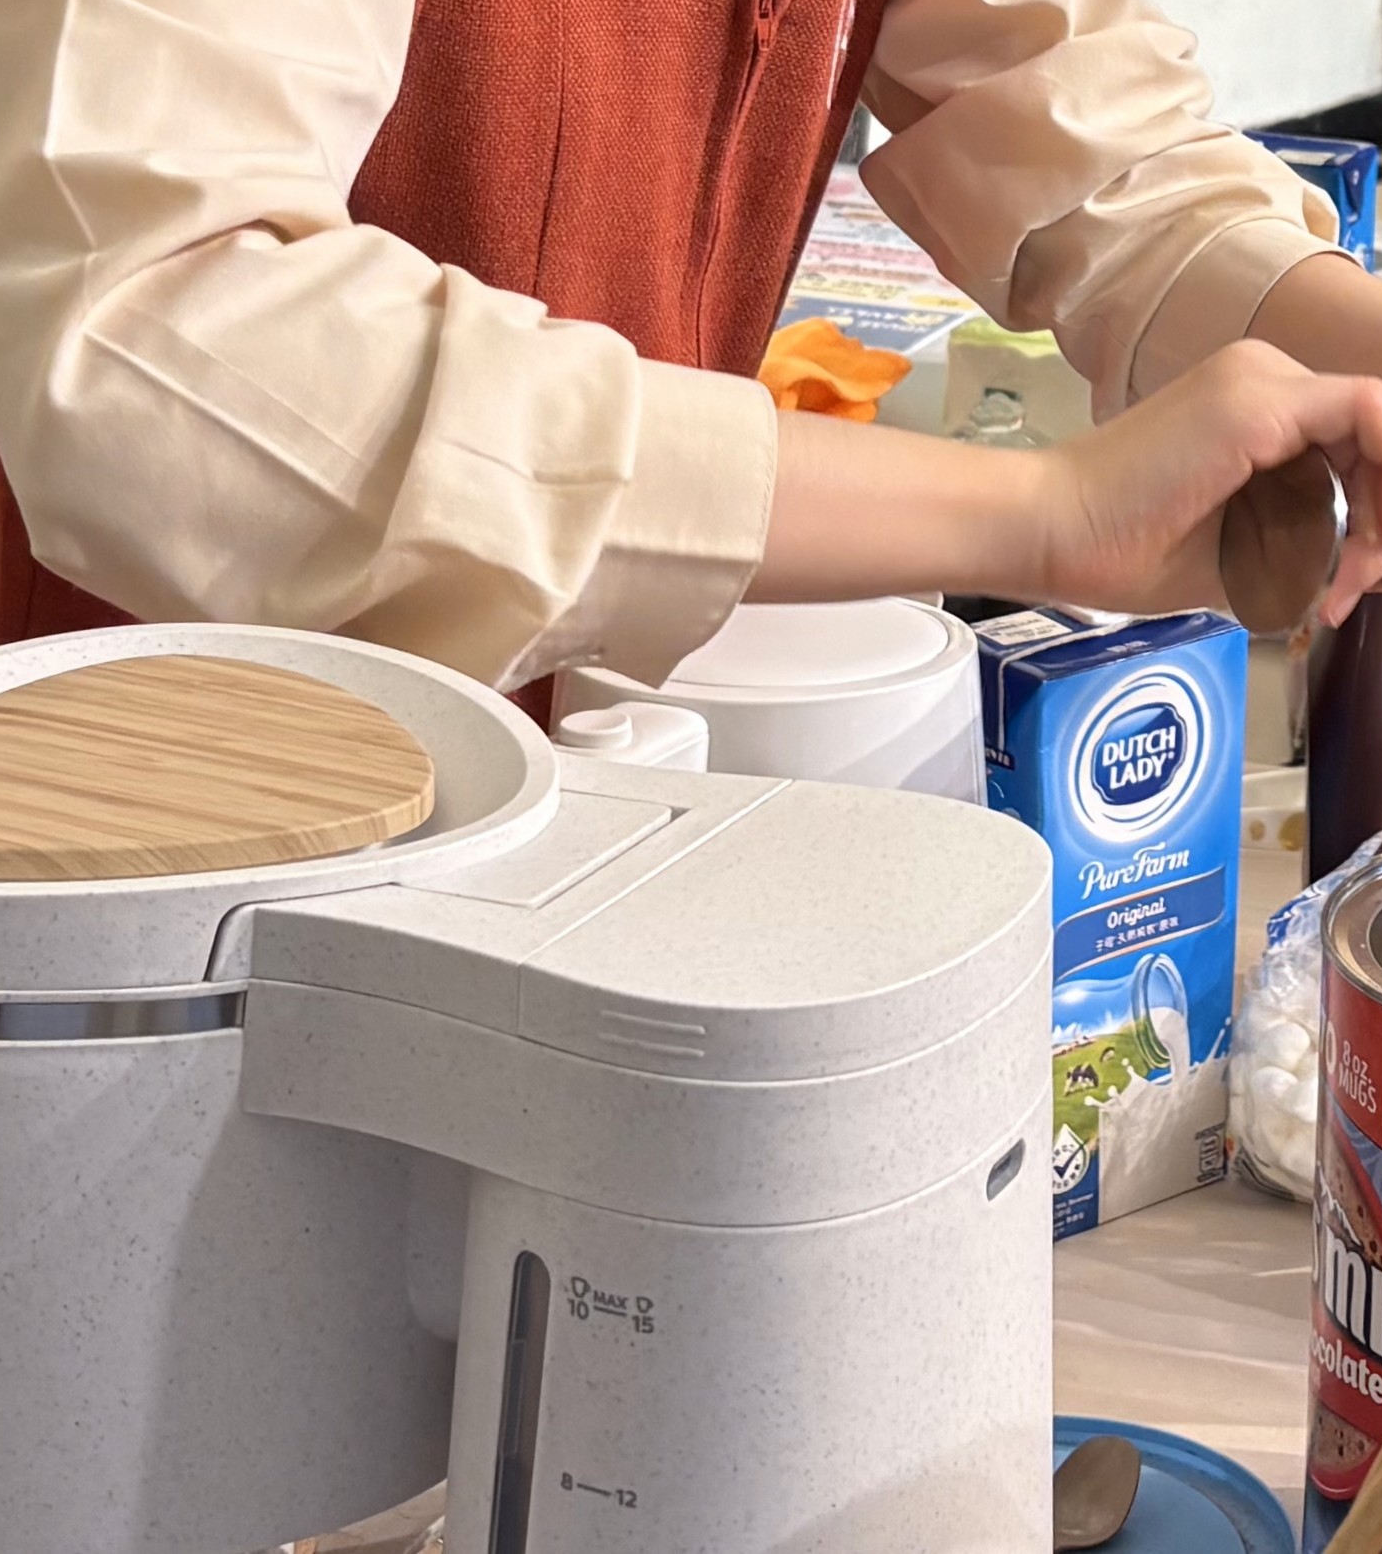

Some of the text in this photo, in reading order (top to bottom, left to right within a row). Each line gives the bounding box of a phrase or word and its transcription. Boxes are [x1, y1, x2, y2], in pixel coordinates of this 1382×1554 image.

[1102, 726, 1176, 767] DUTCH
[1107, 897, 1167, 928] Original
[1342, 1040, 1351, 1067] 8
[1339, 1062, 1377, 1114] MUGS
[568, 1298, 655, 1334] 10 15
[594, 1290, 627, 1311] MAX
[561, 1472, 638, 1509] 8 12
